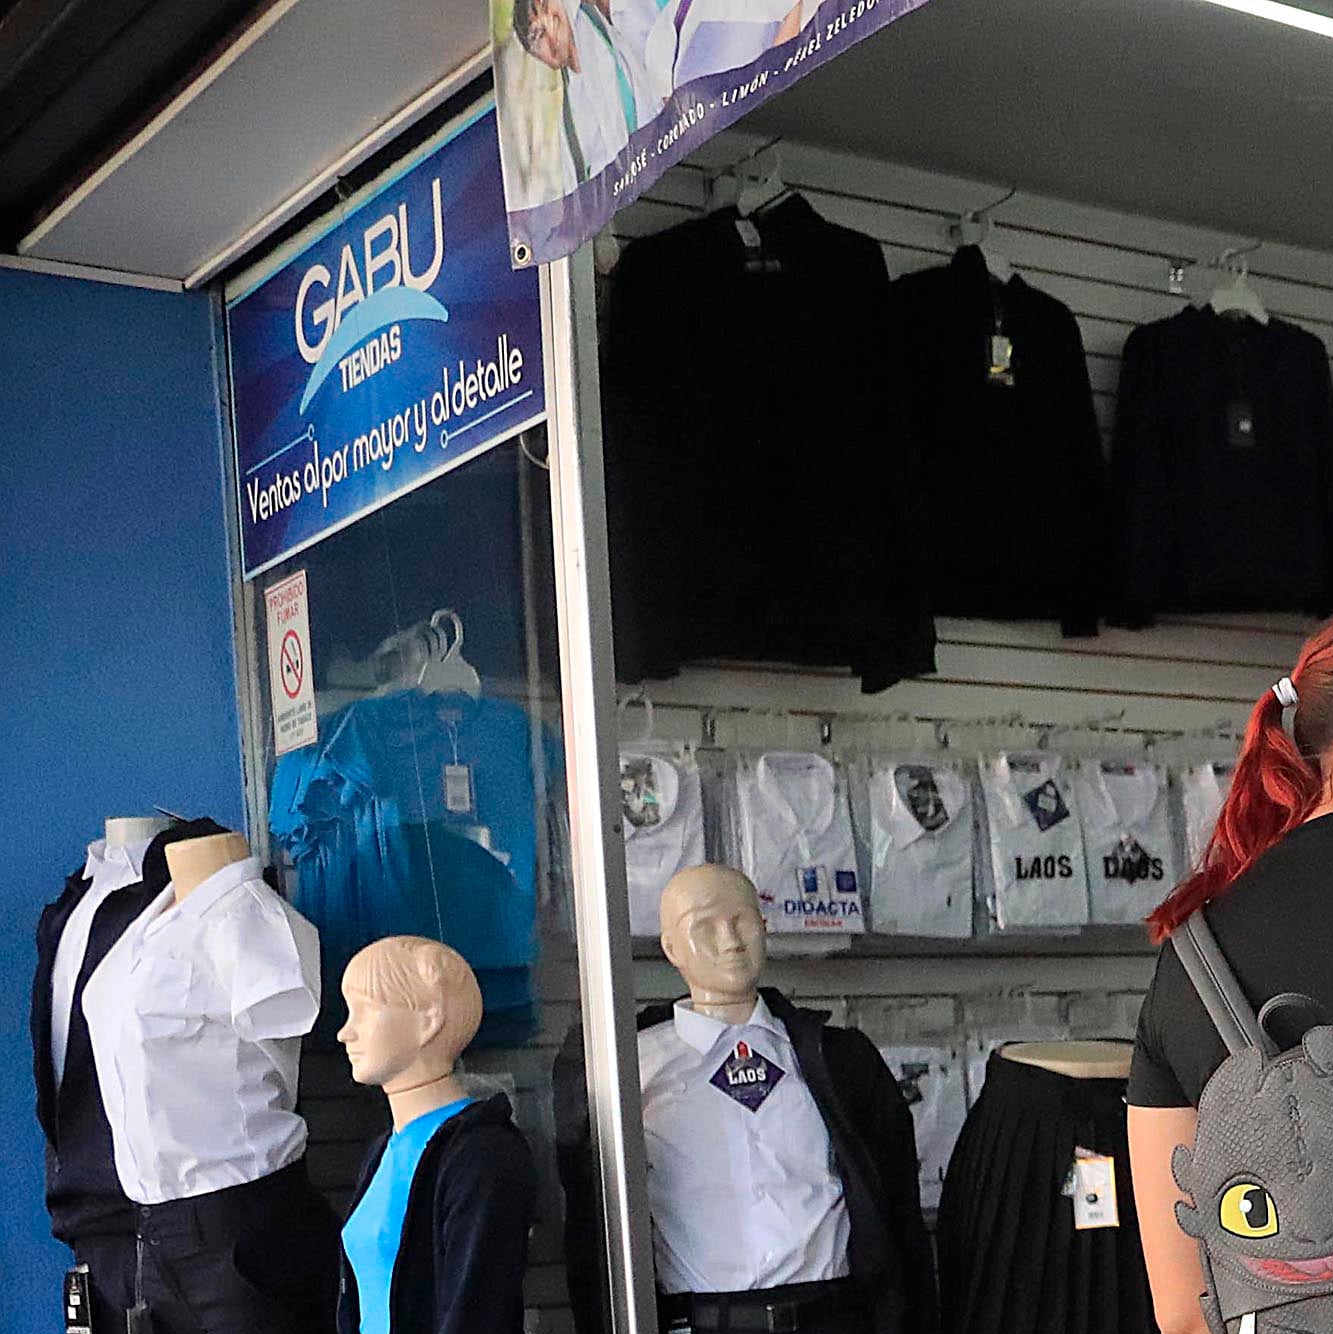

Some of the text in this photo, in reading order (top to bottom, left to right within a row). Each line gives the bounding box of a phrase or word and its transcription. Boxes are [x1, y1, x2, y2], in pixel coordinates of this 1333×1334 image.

[657, 102, 705, 155] CORONADO
[722, 70, 769, 107] LIMÓN
[295, 177, 444, 364] GABU
[338, 325, 402, 393] TIENDAS
[246, 334, 523, 524] Ventas al por mayor y al detalle
[1014, 855, 1073, 880] LAOS
[784, 899, 861, 916] DIDACTA
[728, 1068, 767, 1086] LAOS
